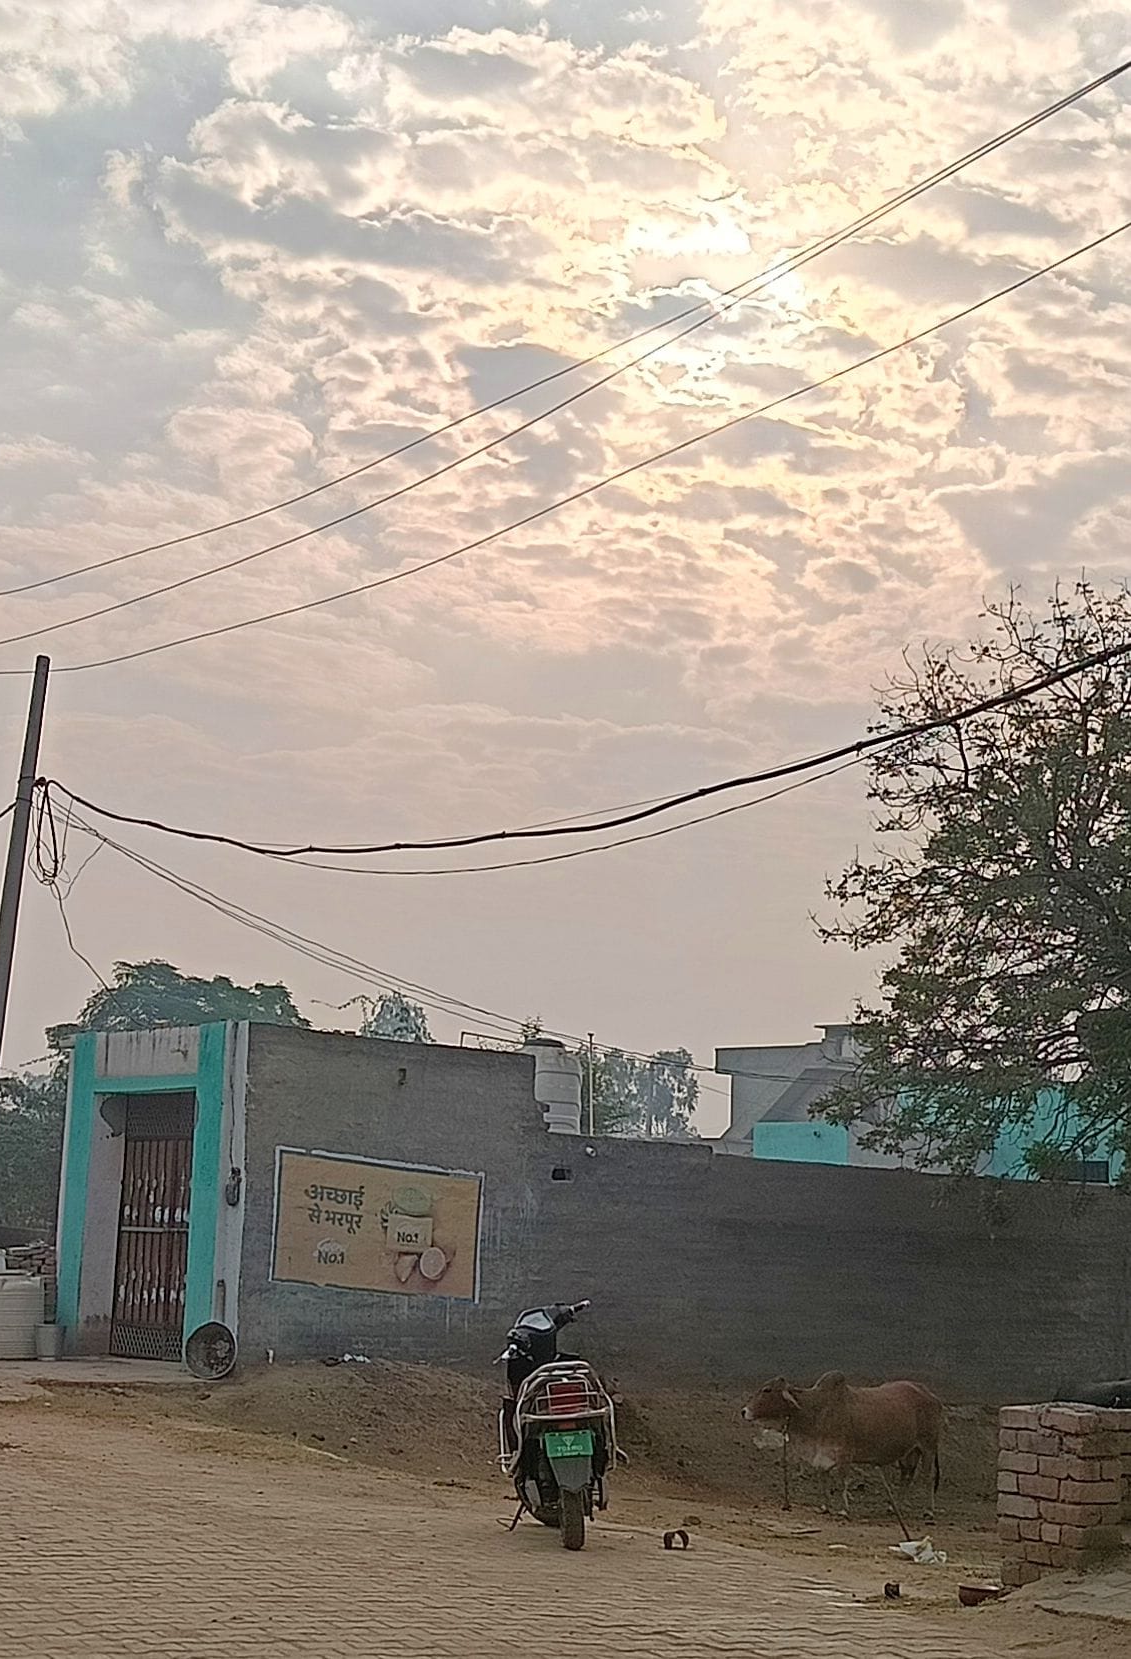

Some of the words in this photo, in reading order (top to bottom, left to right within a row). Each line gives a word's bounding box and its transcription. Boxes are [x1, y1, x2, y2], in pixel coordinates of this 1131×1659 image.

[304, 1184, 365, 1211] अच्छाई
[307, 1203, 322, 1224] से
[324, 1210, 364, 1235] भरपूर
[317, 1250, 345, 1265] No.1
